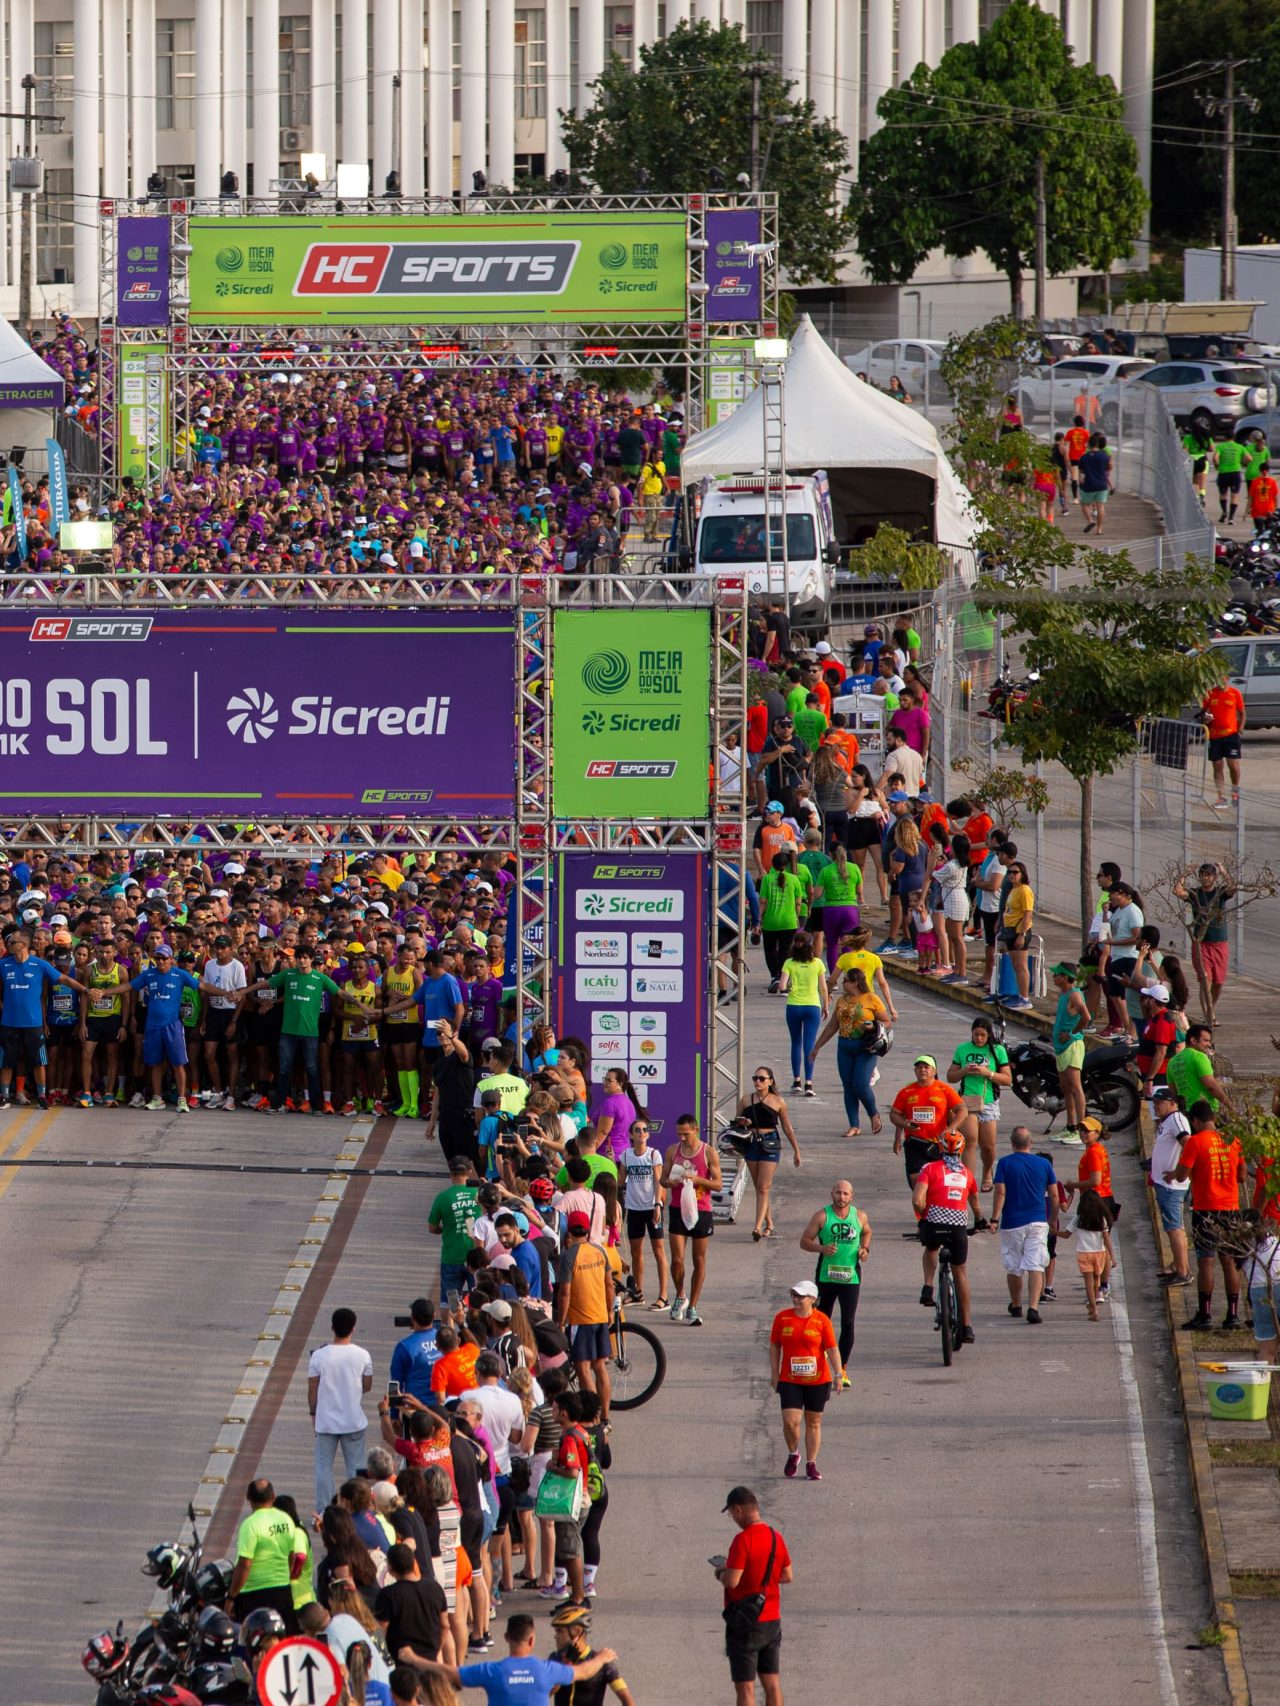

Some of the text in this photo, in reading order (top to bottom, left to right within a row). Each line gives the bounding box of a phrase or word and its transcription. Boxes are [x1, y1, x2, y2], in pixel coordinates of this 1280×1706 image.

[249, 247, 274, 258] MEIA
[633, 243, 658, 255] MEIA
[257, 261, 274, 272] SOL
[312, 255, 557, 283] HC SPORTS
[640, 258, 658, 269] SOL
[232, 284, 273, 295] Sicredi
[616, 281, 657, 292] Sicredi
[38, 623, 143, 635] HC SPORTS
[639, 651, 682, 670] MEIA
[639, 676, 682, 693] DO SOL
[46, 679, 168, 755] SOL
[288, 696, 450, 735] Sicredi
[610, 714, 681, 731] Sicredi
[592, 765, 670, 774] HC SPORTS
[366, 792, 428, 800] HC SPORTS
[619, 868, 660, 876] SPORTS
[609, 897, 674, 913] Sicredi
[585, 950, 618, 958] Nordestão
[584, 975, 619, 987] ICATU
[649, 983, 679, 992] NATAL
[598, 1040, 620, 1055] selfit
[638, 1064, 658, 1077] 96
[269, 1523, 290, 1537] STAFF
